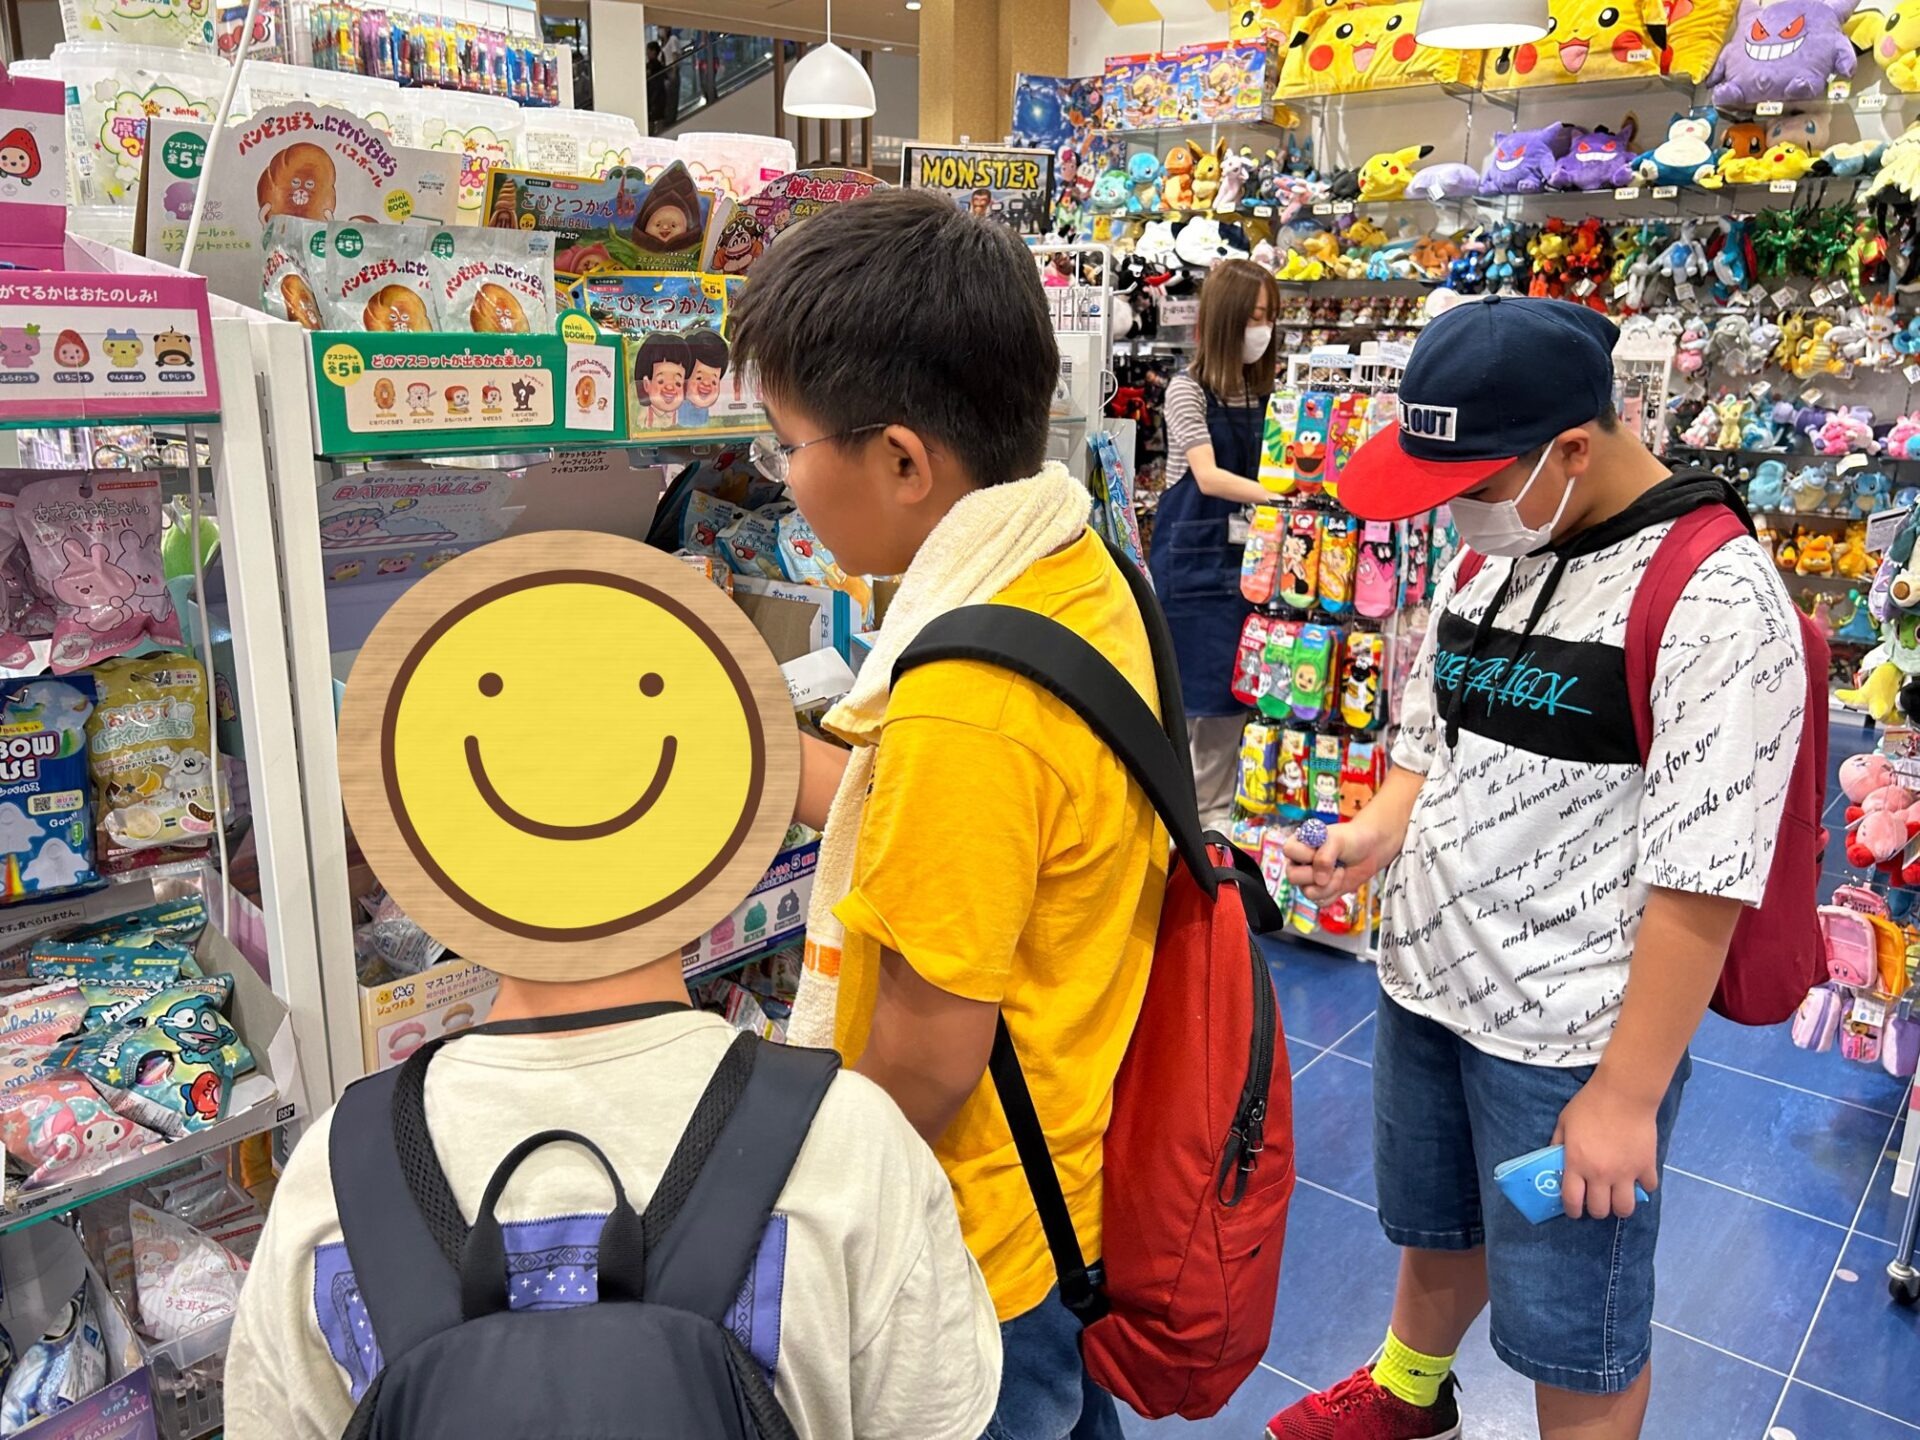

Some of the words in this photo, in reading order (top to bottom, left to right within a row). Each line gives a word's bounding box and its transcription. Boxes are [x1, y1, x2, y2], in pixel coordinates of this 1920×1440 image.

[239, 112, 314, 156] パンどろぼう
[325, 114, 398, 177] にせパンどろぼう
[921, 154, 1039, 190] MONSTER
[387, 200, 410, 213] BOOK
[388, 194, 406, 202] mini
[540, 215, 566, 228] BATH
[568, 217, 592, 230] BALL
[162, 227, 236, 240] バスールから
[163, 240, 251, 251] マスットがでてくる
[341, 259, 398, 299] パンどろぼう
[600, 294, 716, 315] こびとづかん
[619, 316, 650, 328] BATH
[333, 481, 491, 501] BATHBALLS
[1663, 750, 1690, 784] for
[1499, 801, 1519, 824] and
[1519, 769, 1571, 811] honored
[1572, 768, 1585, 782] in
[1558, 788, 1603, 821] nations
[1605, 779, 1619, 794] in
[1501, 920, 1529, 949] and
[1532, 905, 1579, 937] because
[1590, 878, 1620, 906] love
[1620, 863, 1638, 888] yo
[425, 964, 488, 990] マスコットは
[119, 1403, 150, 1424] BALL
